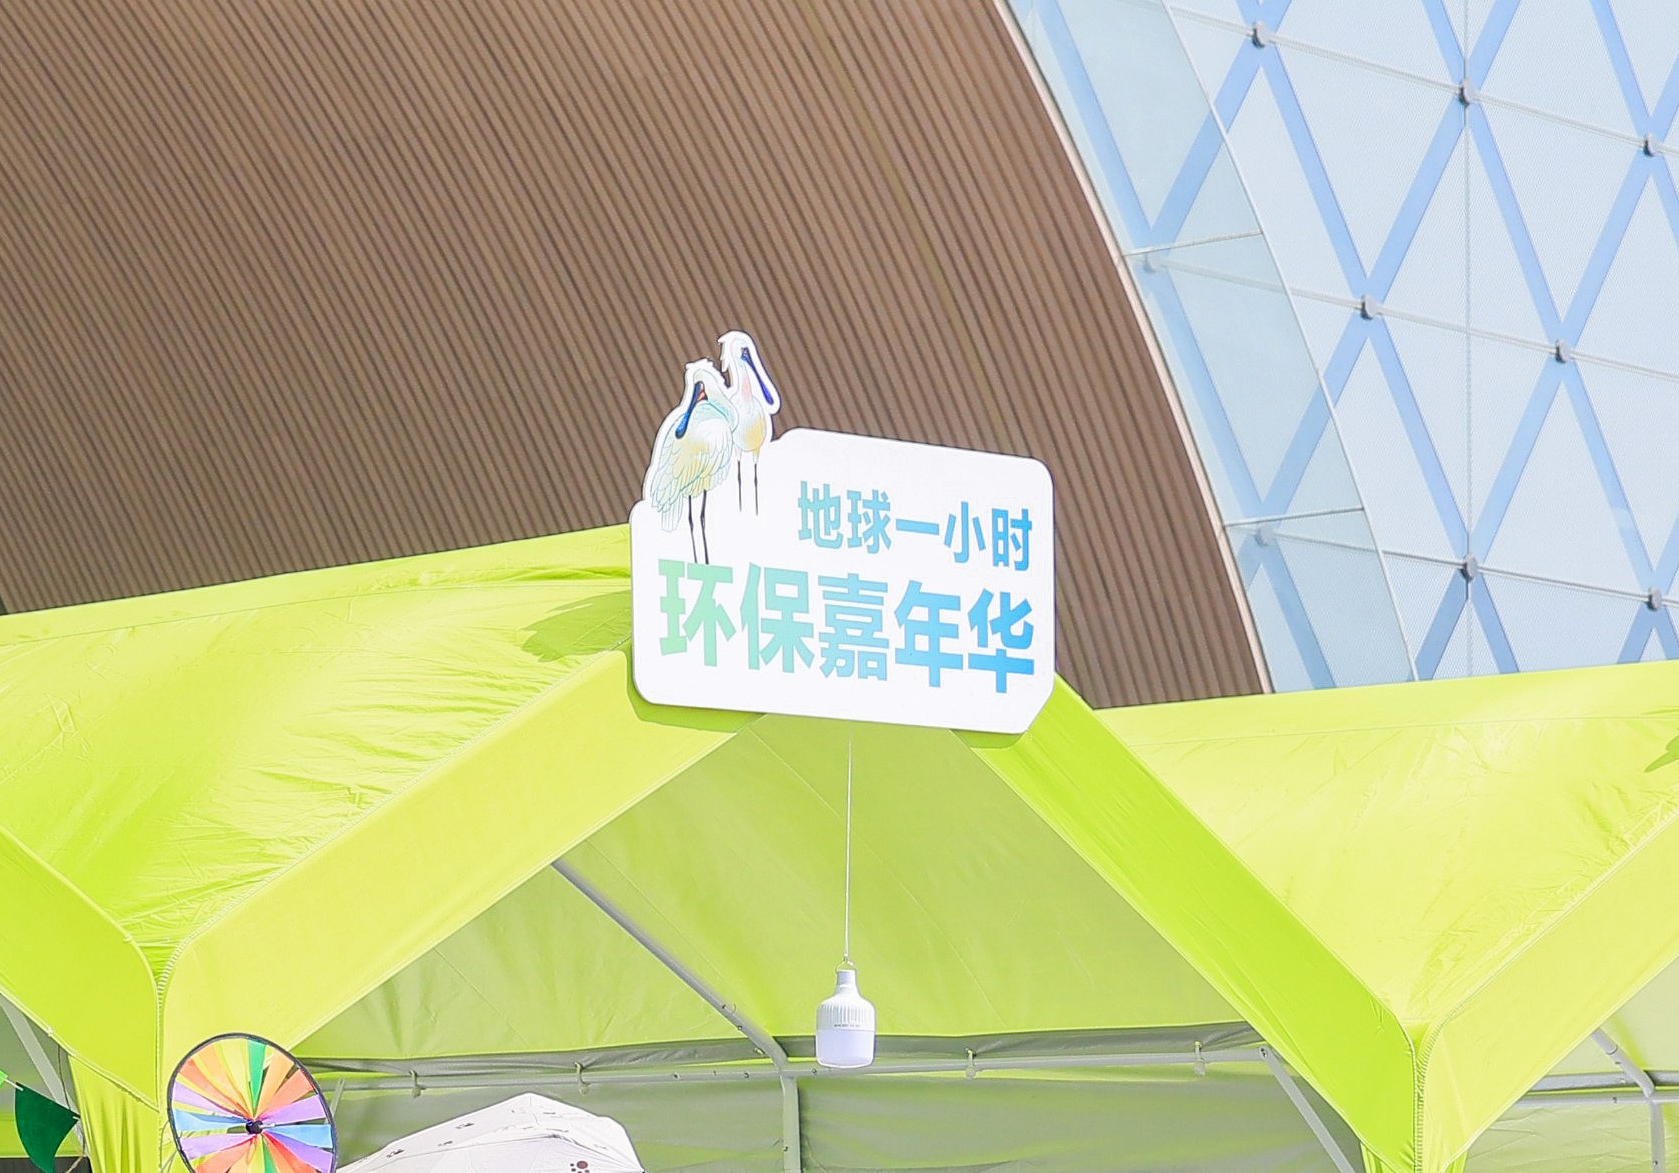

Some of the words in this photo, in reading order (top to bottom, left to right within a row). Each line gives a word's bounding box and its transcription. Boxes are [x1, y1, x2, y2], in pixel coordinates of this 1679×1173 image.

[797, 480, 1033, 572] 地球一小时
[657, 558, 1035, 694] 环保嘉年华
